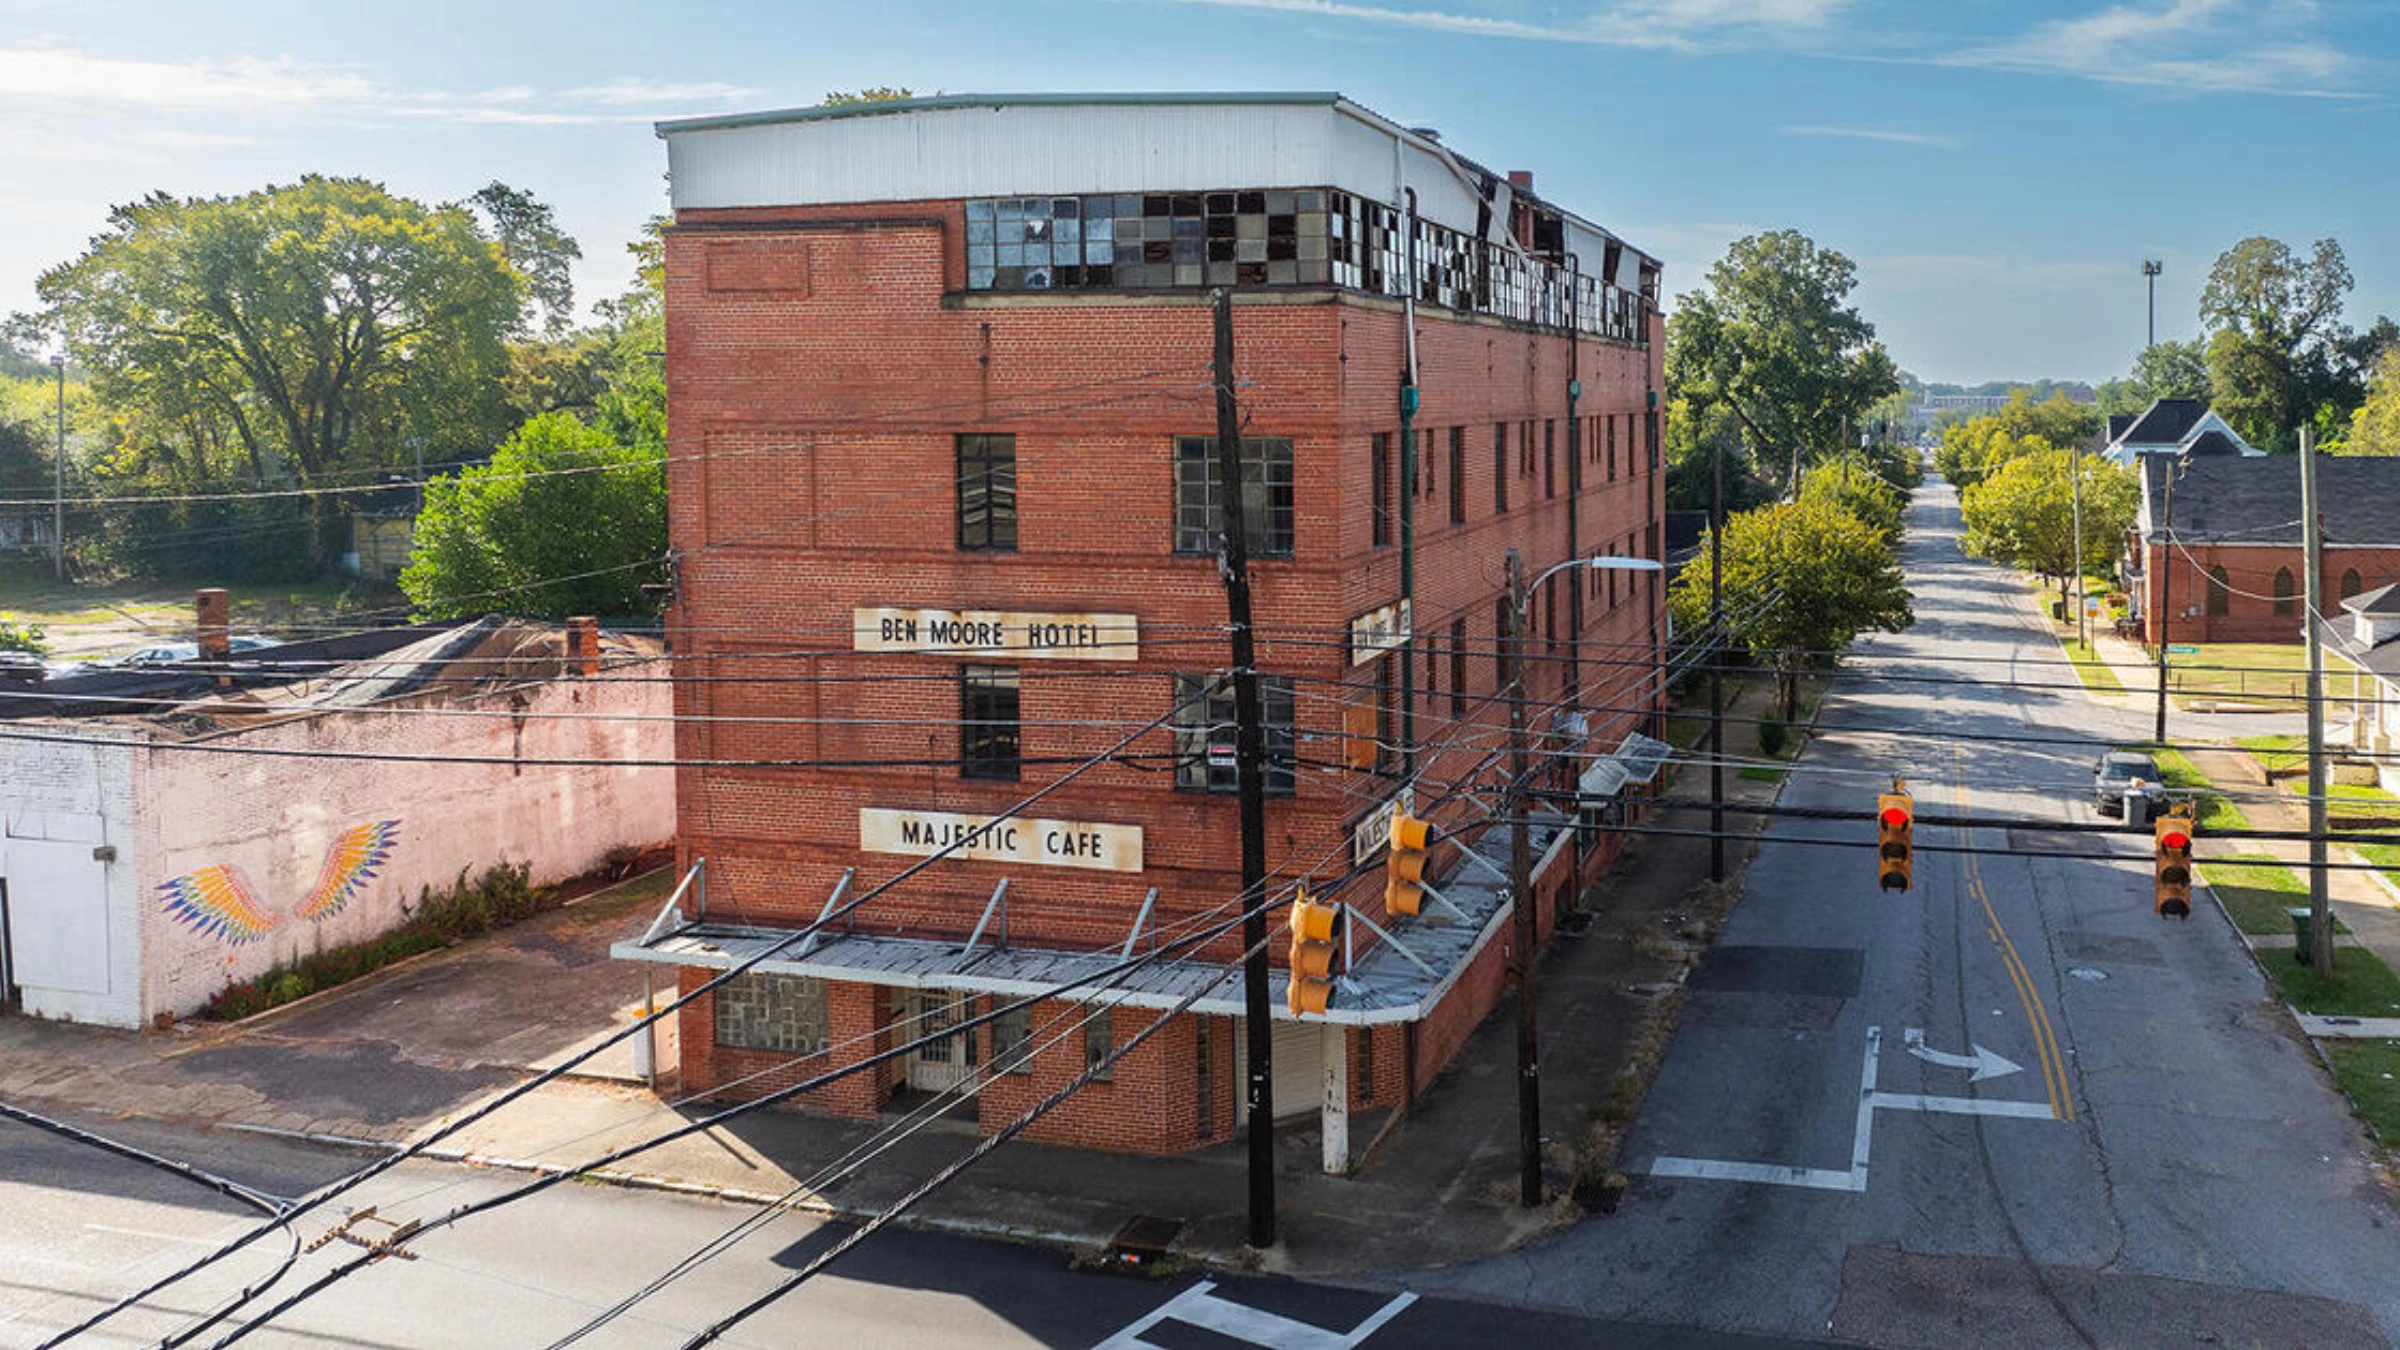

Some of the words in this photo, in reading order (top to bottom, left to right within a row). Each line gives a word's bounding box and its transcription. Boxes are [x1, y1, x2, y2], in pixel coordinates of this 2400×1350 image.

[882, 618, 916, 642] BEN
[931, 619, 1003, 646] MOORE
[1028, 623, 1101, 648] HOTEL
[902, 820, 1017, 851] MAJESTIC
[1046, 831, 1102, 858] CAFE
